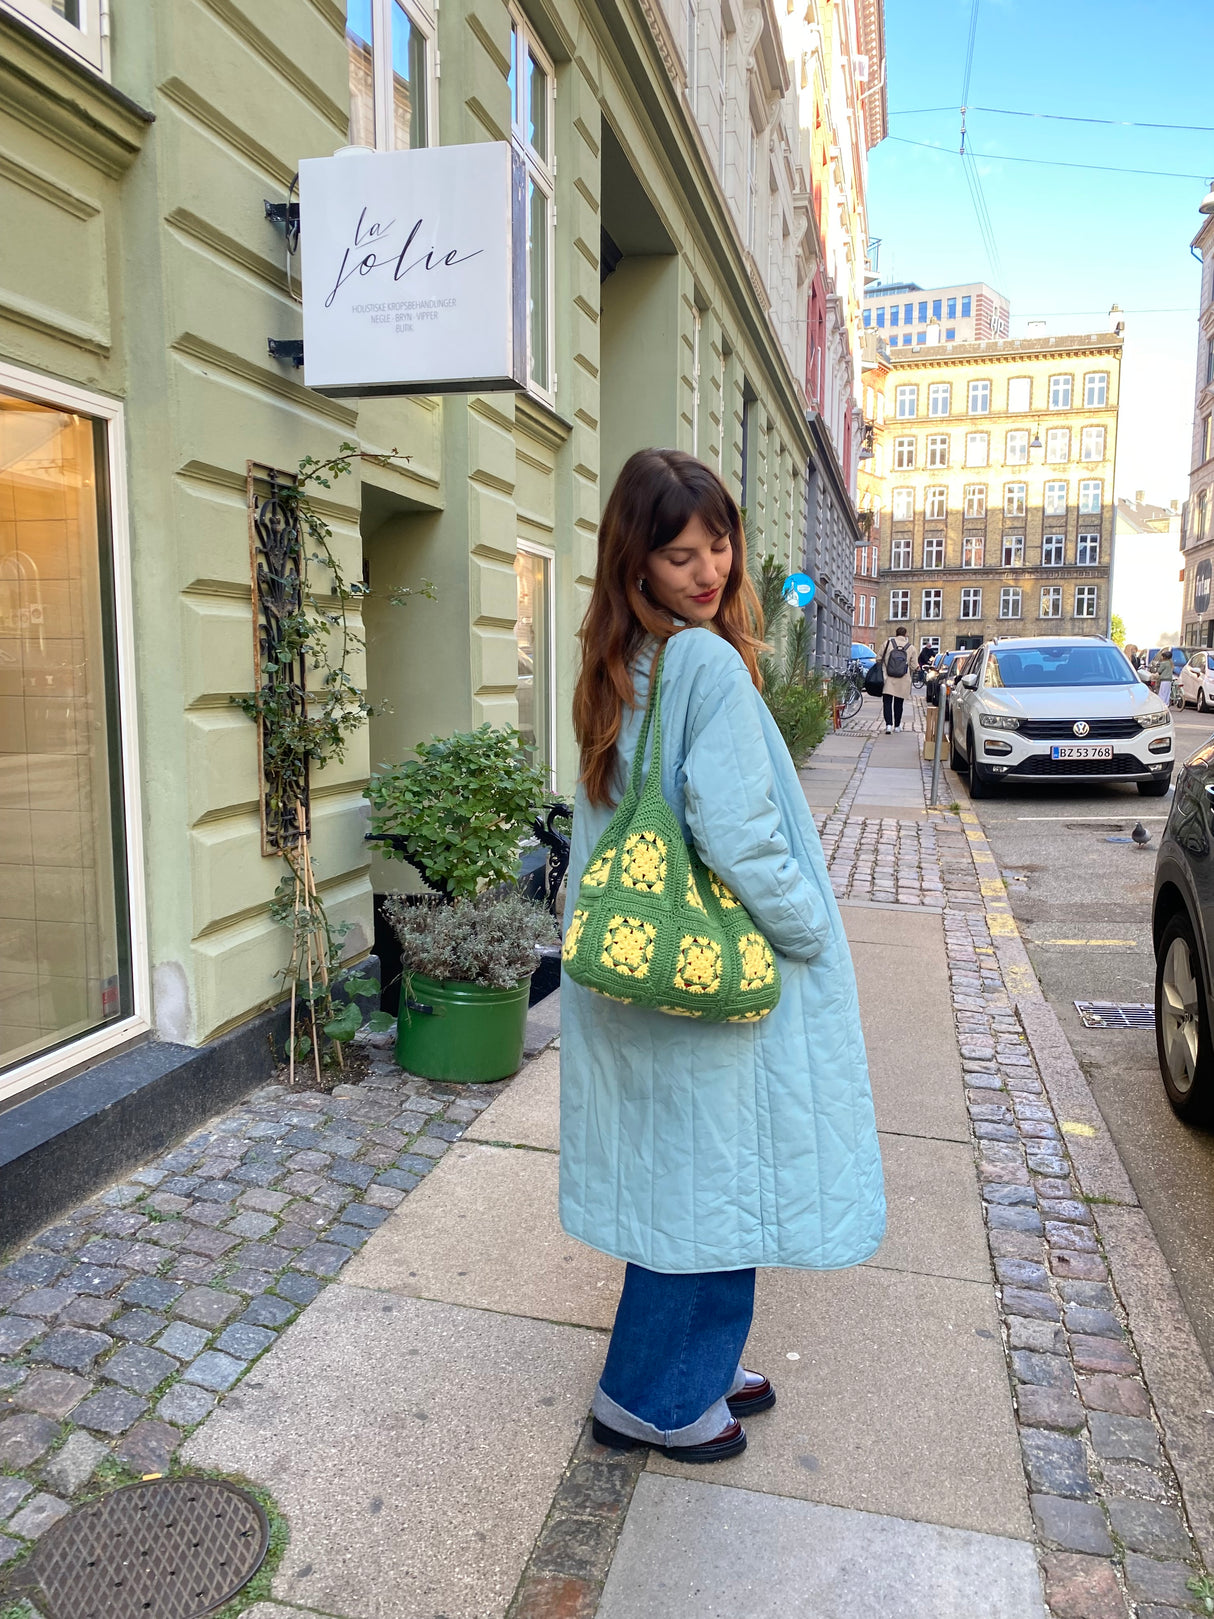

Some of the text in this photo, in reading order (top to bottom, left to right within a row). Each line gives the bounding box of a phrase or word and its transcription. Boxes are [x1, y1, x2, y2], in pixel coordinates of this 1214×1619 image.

[370, 310, 439, 324] NEGLE BRYN VIPPER
[1060, 747, 1111, 758] BZ 53 768
